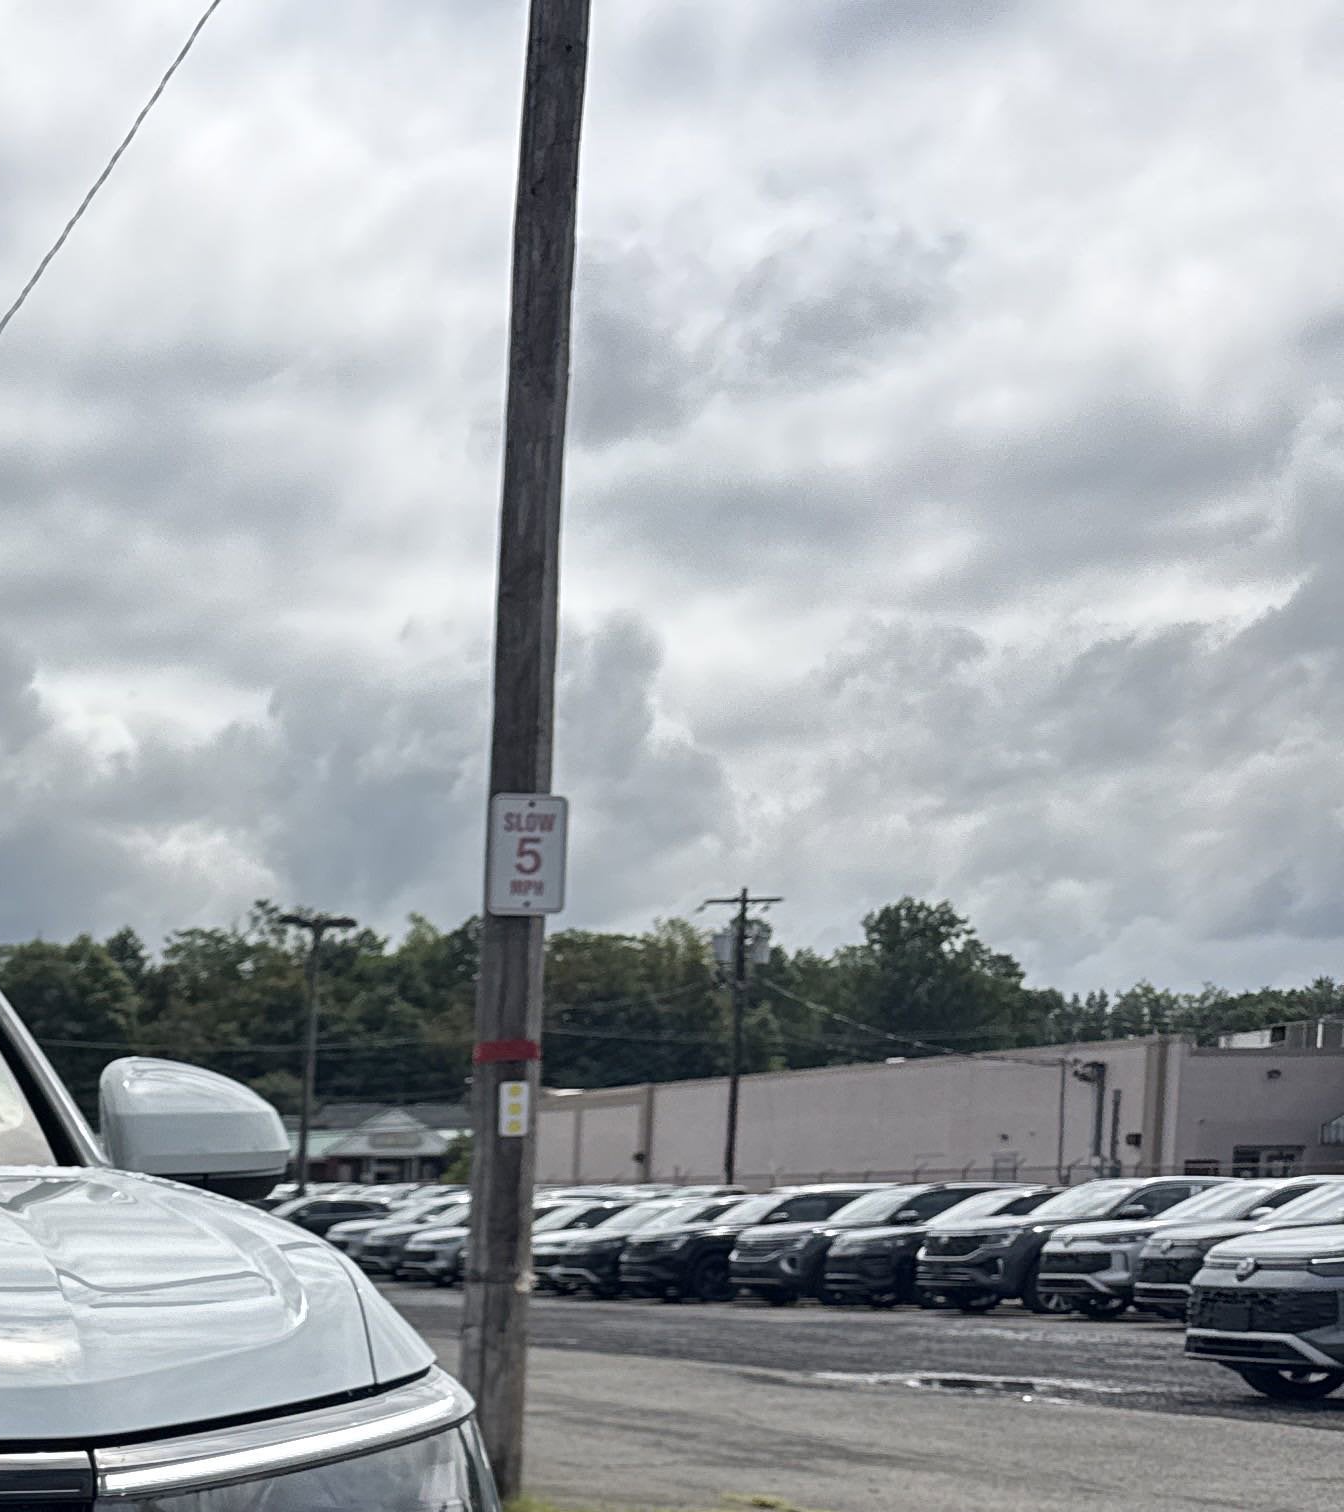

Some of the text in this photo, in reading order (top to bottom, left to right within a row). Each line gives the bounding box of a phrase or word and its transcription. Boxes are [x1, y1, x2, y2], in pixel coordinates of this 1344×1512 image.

[503, 812, 556, 832] SLOW
[515, 837, 542, 875] 5
[510, 880, 545, 896] MPH
